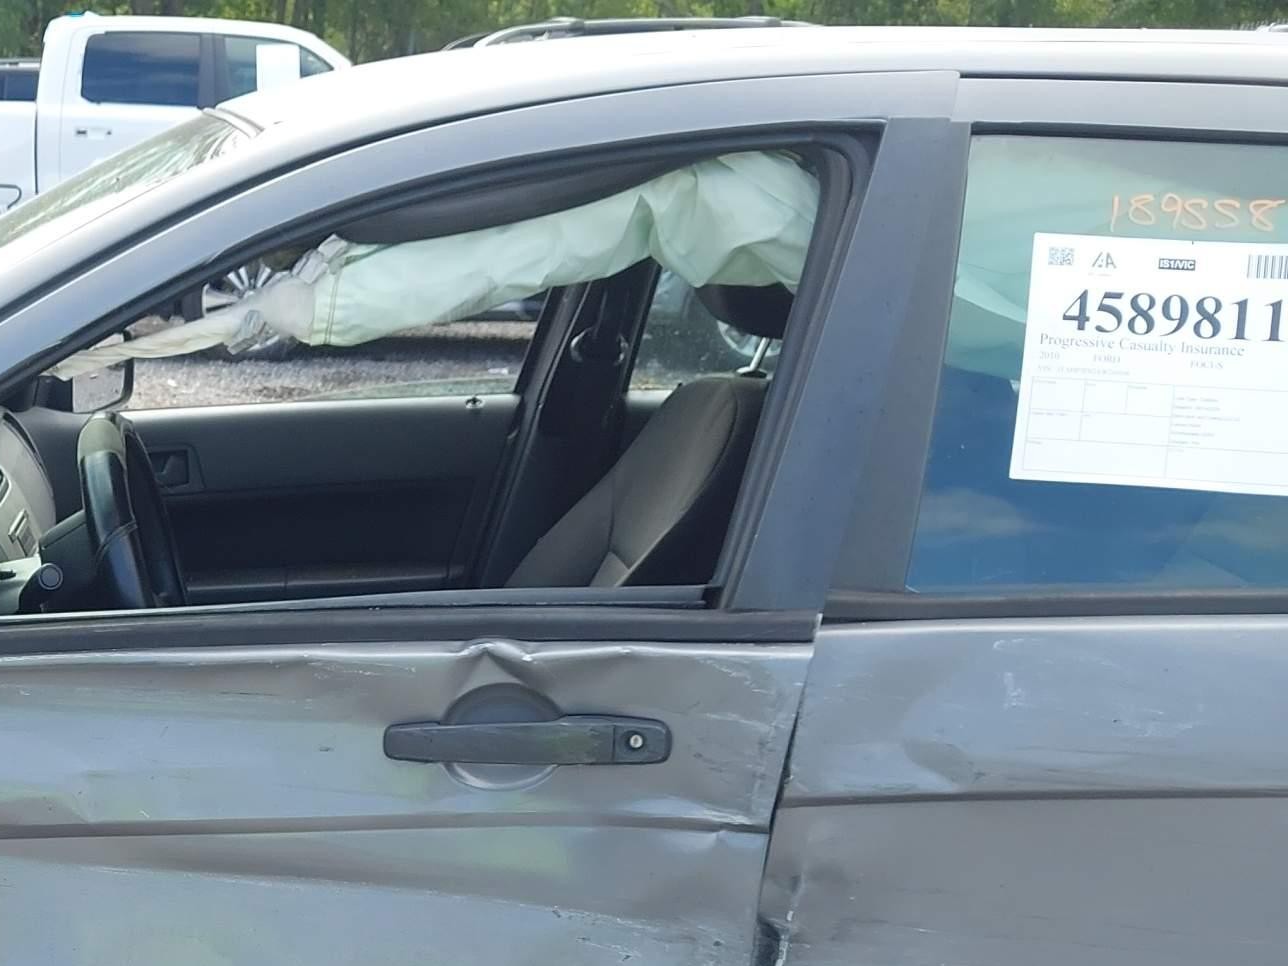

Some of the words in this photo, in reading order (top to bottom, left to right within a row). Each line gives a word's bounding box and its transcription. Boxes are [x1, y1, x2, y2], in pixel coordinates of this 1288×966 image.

[1061, 288, 1287, 343] 4589811
[1039, 332, 1115, 350] Progressive
[1119, 337, 1175, 356] Casualty
[1181, 341, 1246, 357] Insurance
